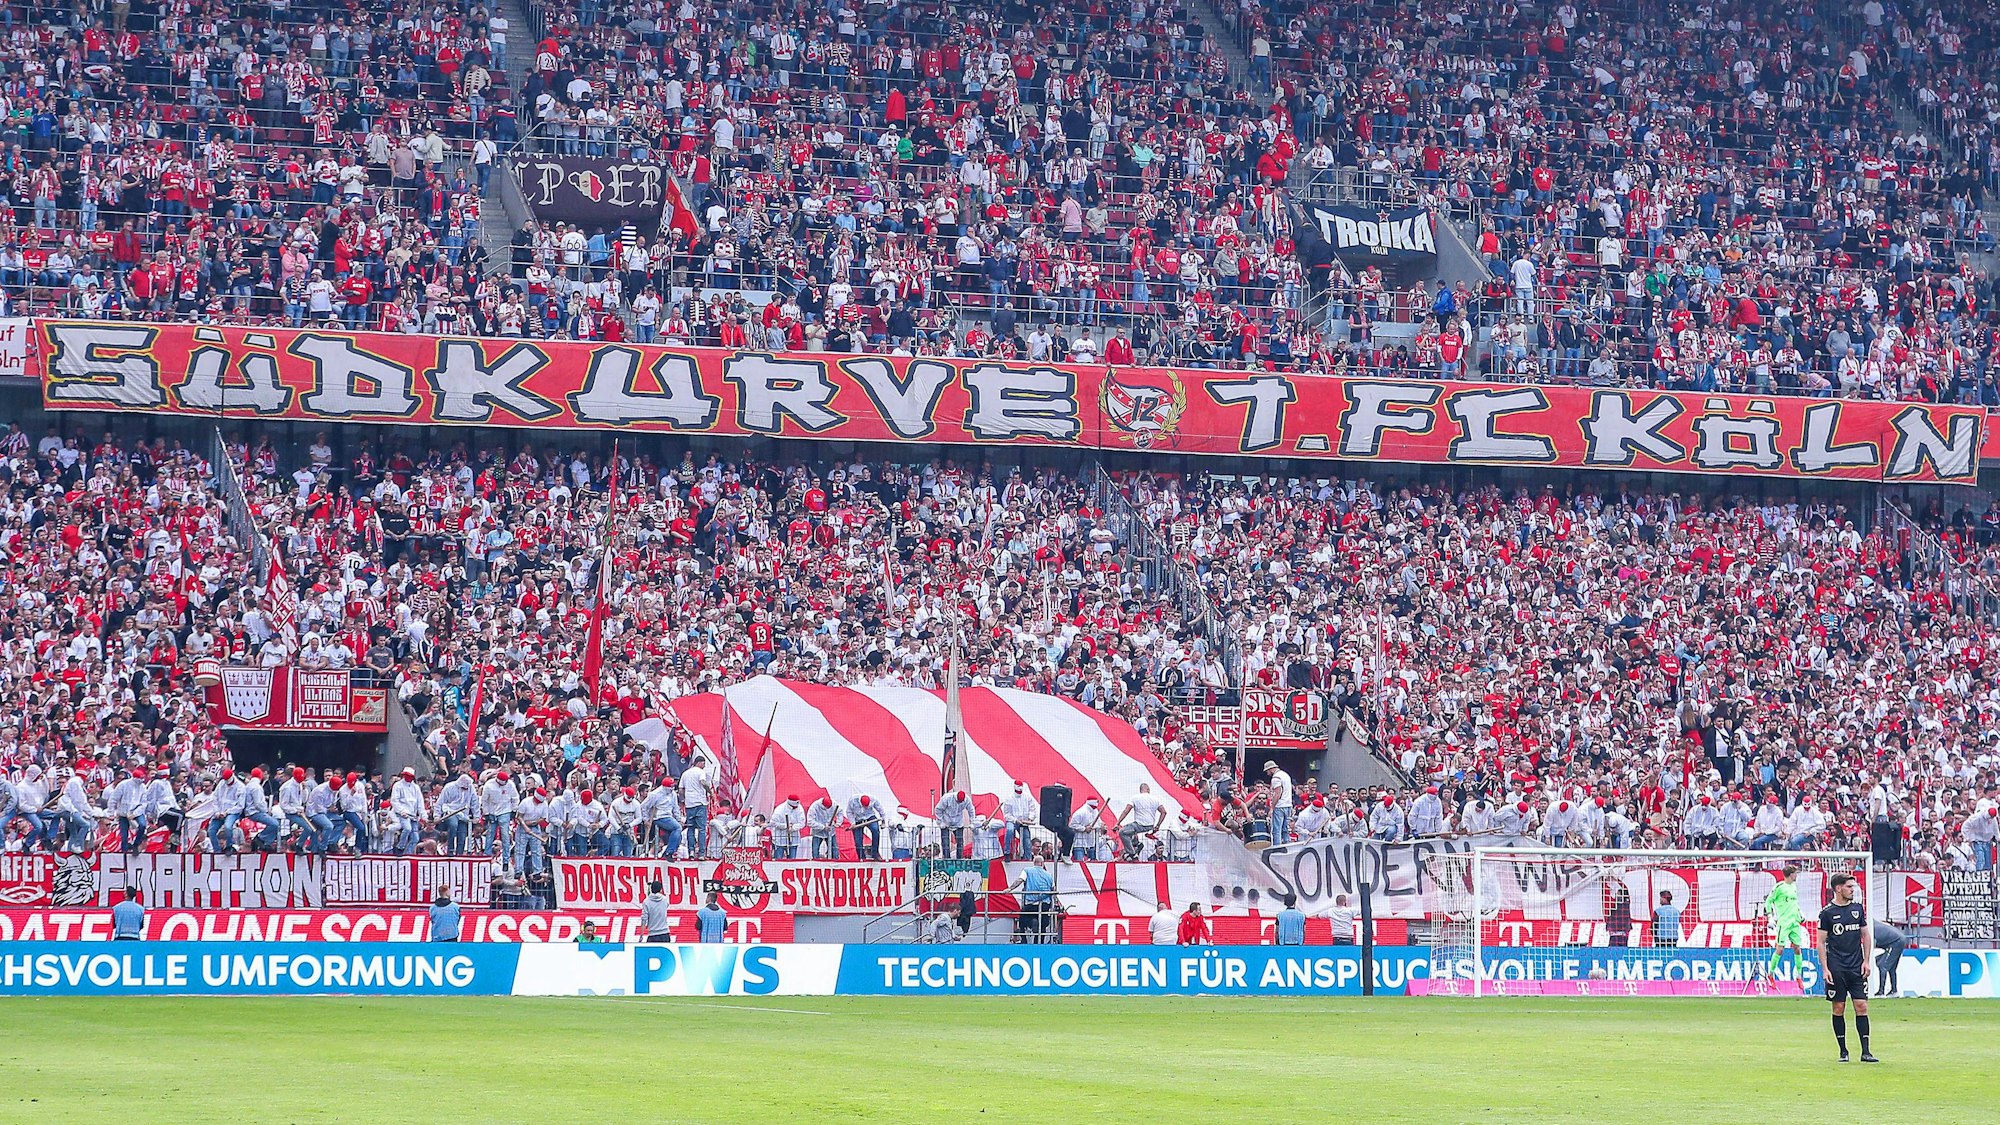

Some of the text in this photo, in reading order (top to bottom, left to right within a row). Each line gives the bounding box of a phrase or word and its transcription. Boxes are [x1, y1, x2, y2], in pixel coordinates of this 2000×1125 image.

[566, 238, 581, 250] 66
[1314, 207, 1437, 255] TROIKA
[44, 320, 1083, 442] SÜDKURVE
[1578, 389, 1981, 480] KÖLN
[1131, 395, 1158, 421] 12
[347, 558, 360, 569] 10
[754, 627, 766, 641] 13
[1245, 693, 1285, 713] SPS
[1245, 716, 1285, 736] CGN
[324, 859, 491, 904] SEMPER FIDELIS
[781, 866, 906, 907] SYNDIKAT
[1941, 870, 1991, 883] VIRAGE
[1942, 883, 1992, 895] AUTEUIL
[0, 953, 475, 988] HSVOLLE UMFORMUNG
[633, 945, 780, 995] PWS
[877, 956, 1167, 988] TECHNOLOGIEN
[1180, 949, 1248, 988] FÜR
